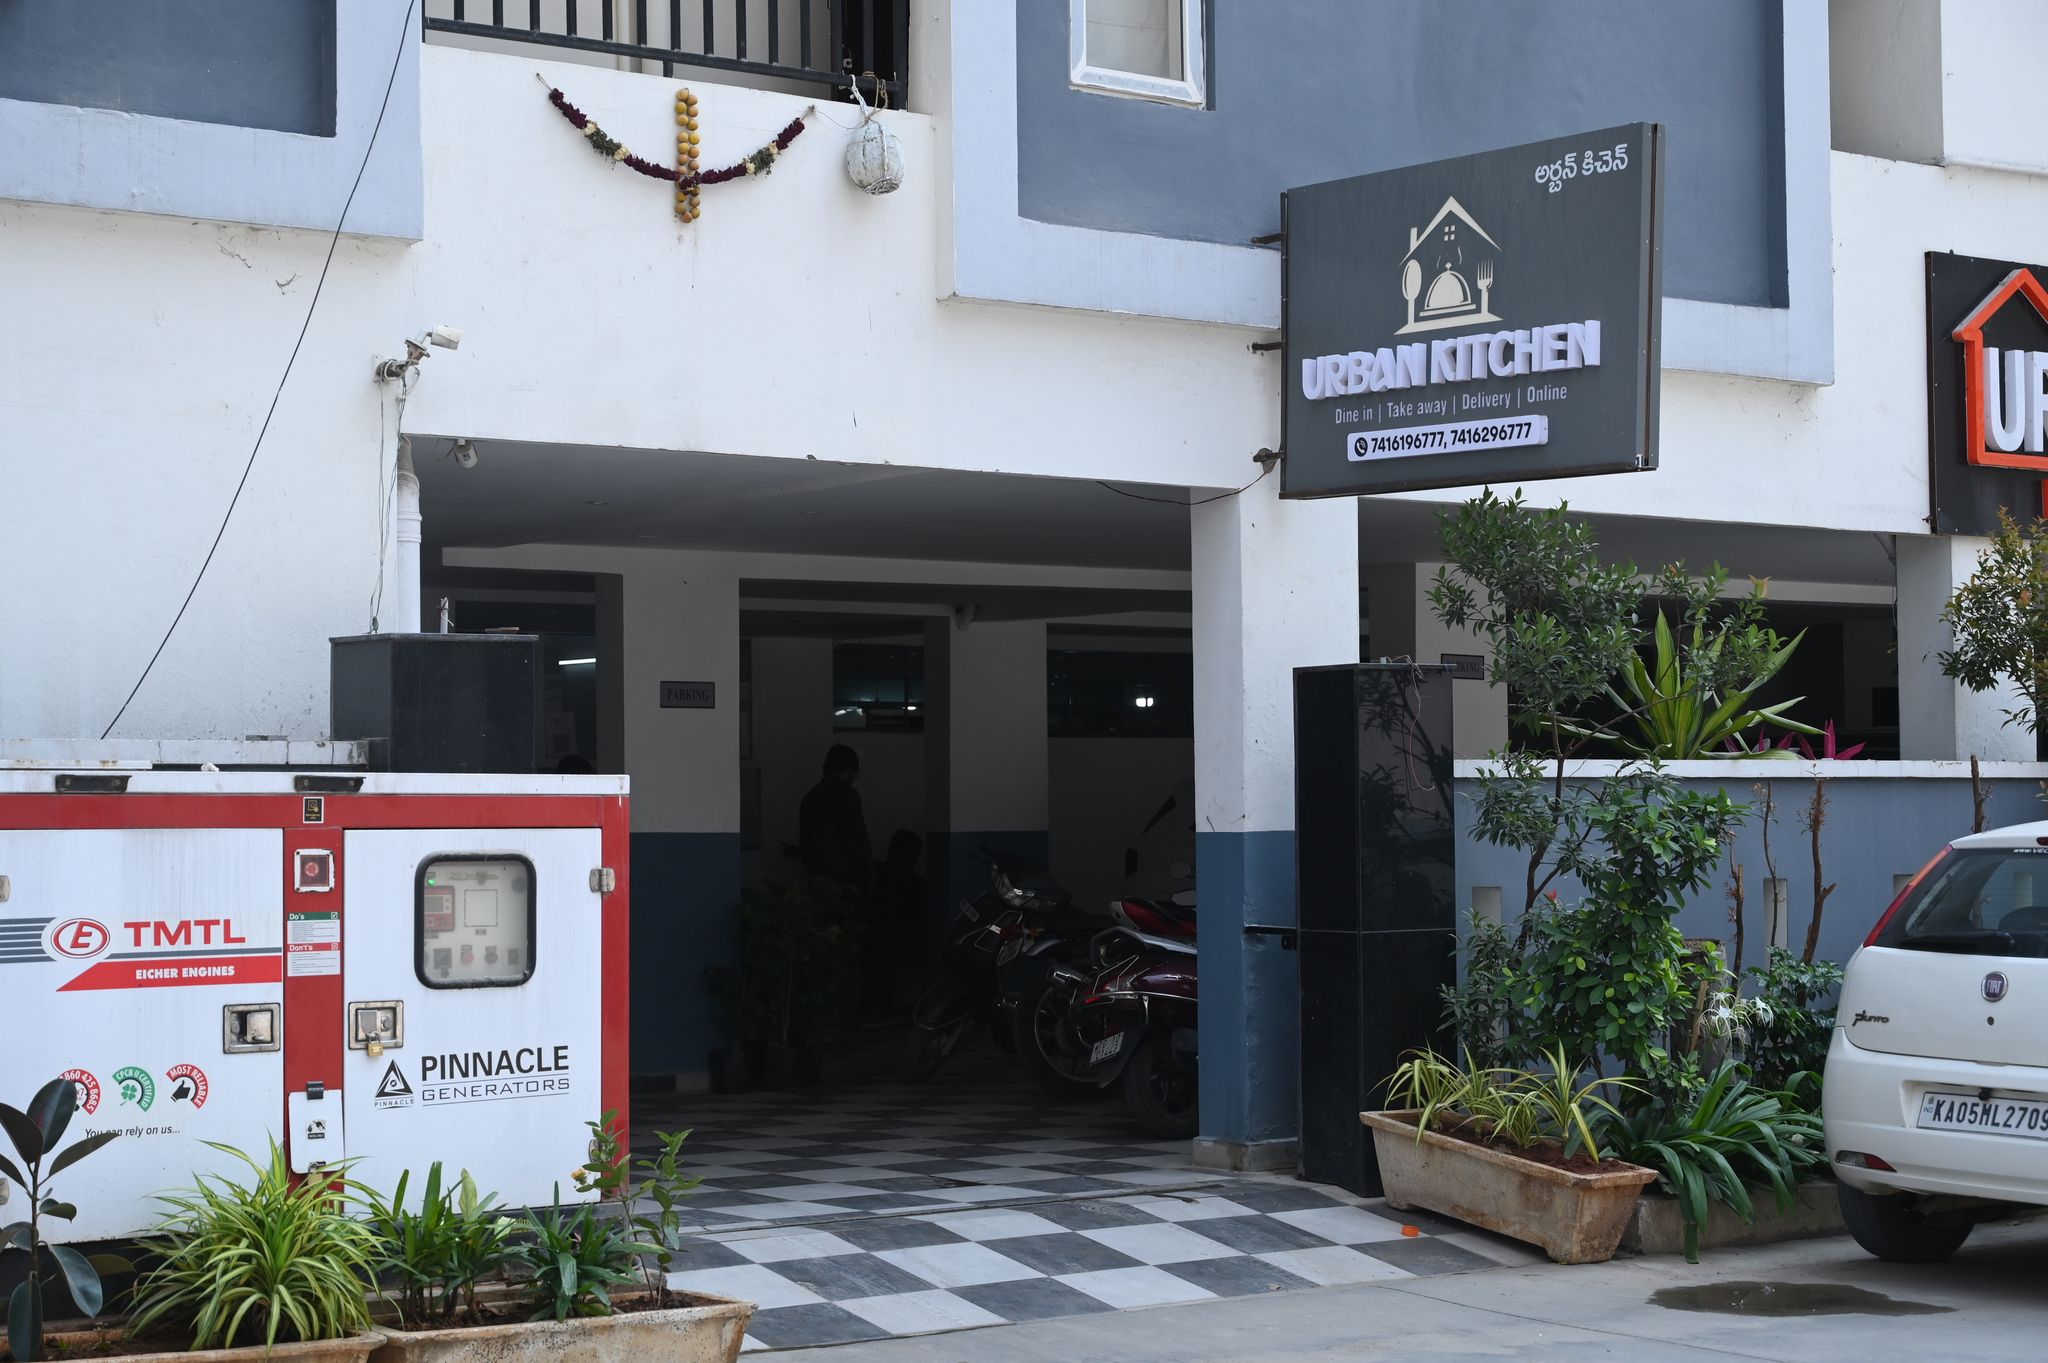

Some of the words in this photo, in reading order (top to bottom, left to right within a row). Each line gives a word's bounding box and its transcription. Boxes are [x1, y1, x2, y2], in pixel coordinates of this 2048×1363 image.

[1582, 143, 1628, 175] కిచెన్
[1302, 342, 1427, 400] URBAN
[1430, 319, 1601, 384] KITCHEN
[1335, 407, 1359, 424] Dine
[1363, 405, 1373, 420] in
[1387, 401, 1413, 419] Take
[1417, 399, 1447, 416] away
[1462, 391, 1511, 410] Delivery
[1527, 384, 1568, 403] Online
[1371, 430, 1447, 453] 7416196777,
[1450, 421, 1532, 446] 7416296777
[667, 687, 710, 702] PARKING
[289, 912, 305, 920] Do's
[124, 918, 246, 947] TMTL
[135, 968, 179, 980] EICHER
[182, 965, 235, 978] ENGINES
[1987, 979, 2003, 994] FIAT
[60, 1070, 81, 1081] 860
[421, 1045, 570, 1082] PINNACLE
[81, 1073, 97, 1088] 425
[115, 1068, 133, 1080] CPCB
[138, 1073, 153, 1108] CERTIFIED
[169, 1065, 191, 1078] MOST
[190, 1069, 207, 1106] RELIABLE
[422, 1078, 570, 1101] GENERATORS
[86, 1088, 99, 1112] 8685
[374, 1098, 415, 1107] PINNACLE
[1932, 1099, 2048, 1131] KA05ML2709
[125, 1126, 143, 1138] rely
[145, 1127, 158, 1135] on
